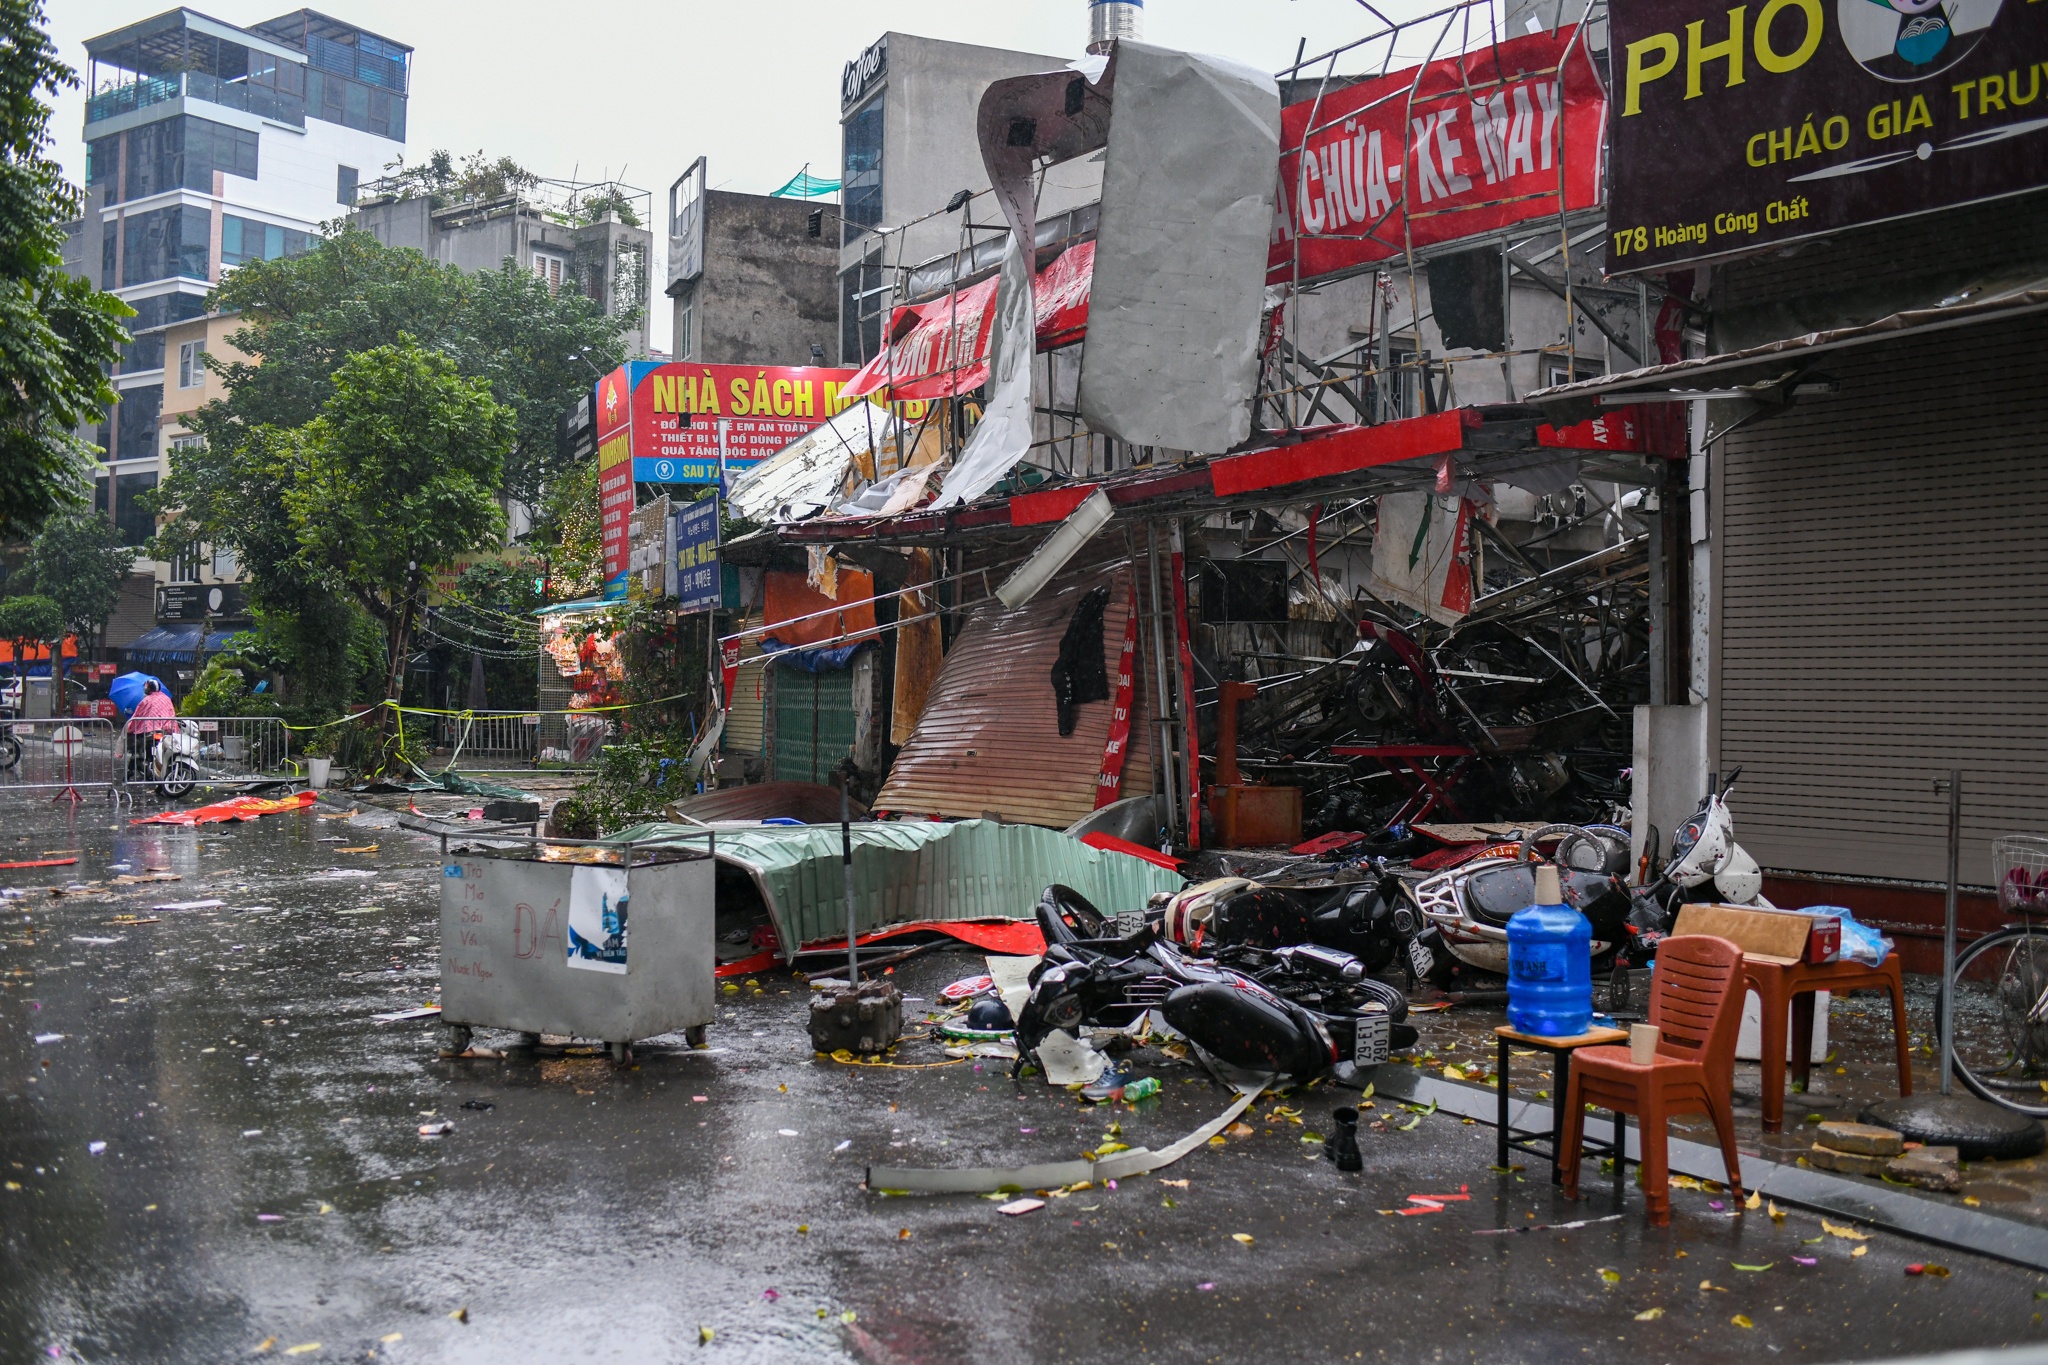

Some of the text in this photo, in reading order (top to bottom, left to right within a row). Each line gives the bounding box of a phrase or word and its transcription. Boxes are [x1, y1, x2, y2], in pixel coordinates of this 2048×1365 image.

[842, 46, 881, 100] Coffee
[1746, 61, 2048, 168] CHÁO GIA TRU
[1412, 108, 1473, 204] XE
[1613, 195, 1809, 257] 178 Hoàng Công Chất
[653, 369, 720, 415] NHÀ
[730, 371, 814, 418] SÁCH
[661, 431, 693, 443] THIẾT
[697, 434, 709, 445] BỊ
[731, 432, 746, 444] ĐỒ
[750, 433, 782, 445] DÙNG
[681, 421, 708, 431] HƠI
[712, 420, 733, 431] TẺ
[737, 422, 754, 431] EM
[758, 423, 775, 433] AN
[778, 422, 808, 433] TOÀN
[1624, 420, 1634, 440] XE
[599, 431, 630, 473] MINHBOOK
[661, 445, 686, 456] QUÀ
[689, 445, 720, 457] TẶNG
[683, 465, 704, 478] SAU
[1114, 708, 1126, 721] TU
[1105, 740, 1120, 754] XE
[1526, 961, 1546, 972] ANH
[1357, 1026, 1373, 1060] 29-E1
[1373, 1020, 1389, 1062] 290.11
